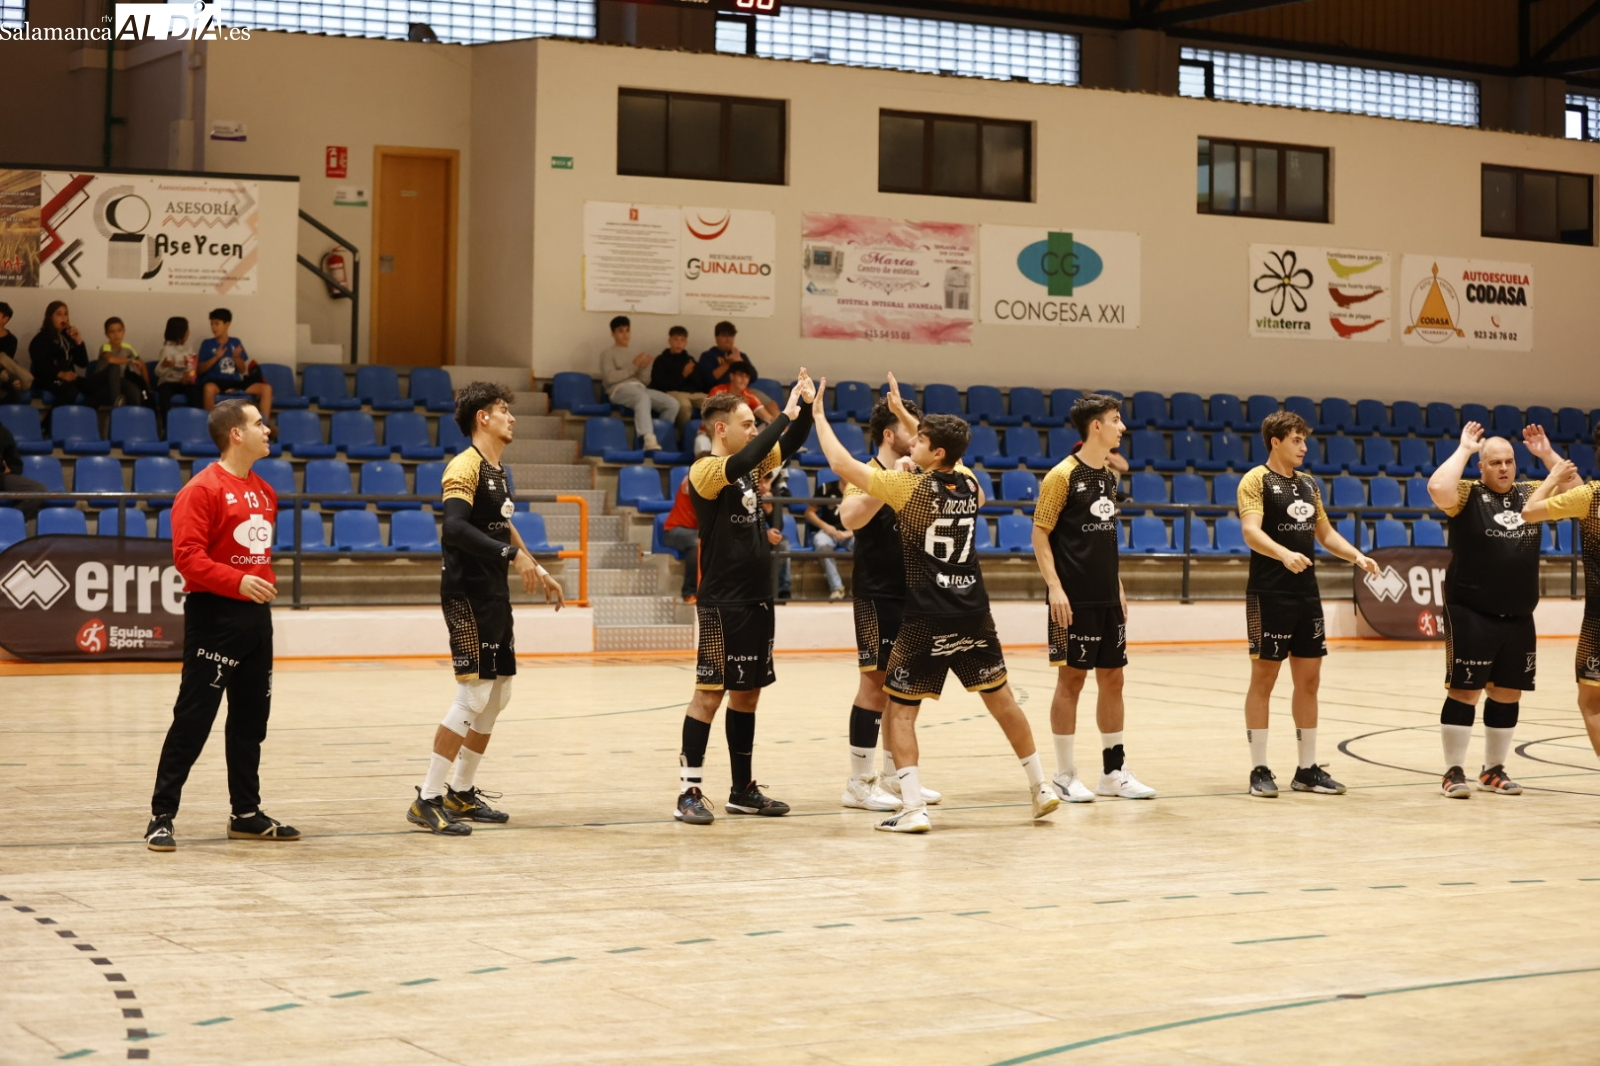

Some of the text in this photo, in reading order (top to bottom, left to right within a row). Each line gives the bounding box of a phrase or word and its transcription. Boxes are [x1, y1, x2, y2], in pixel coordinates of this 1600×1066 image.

[166, 201, 239, 217] ASESORÍA
[709, 254, 753, 262] RESTAURANTE
[1041, 251, 1080, 277] CG
[685, 257, 771, 280] GUINALDO
[857, 264, 882, 274] Centro
[883, 265, 891, 274] de
[1462, 270, 1530, 286] AUTOESCUELA
[1466, 283, 1528, 307] CODASA
[837, 298, 943, 311] ESTÉTICA INTEGRAL AVANZADA
[995, 299, 1125, 324] CONGESA XXI
[1256, 317, 1312, 331] vitaterra
[1420, 316, 1450, 326] CODASA
[1473, 330, 1518, 341] 923 26 76 02
[1291, 483, 1300, 497] 2
[244, 491, 260, 508] 13
[1502, 497, 1511, 509] 6
[1099, 503, 1111, 514] CG
[1294, 505, 1308, 516] CG
[1502, 514, 1519, 525] CG
[248, 526, 268, 542] CG
[924, 517, 975, 564] 67
[1484, 528, 1527, 539] CONGESA
[108, 636, 144, 650] Sport
[196, 647, 240, 668] Pubeer
[1455, 658, 1493, 666] Pubeer
